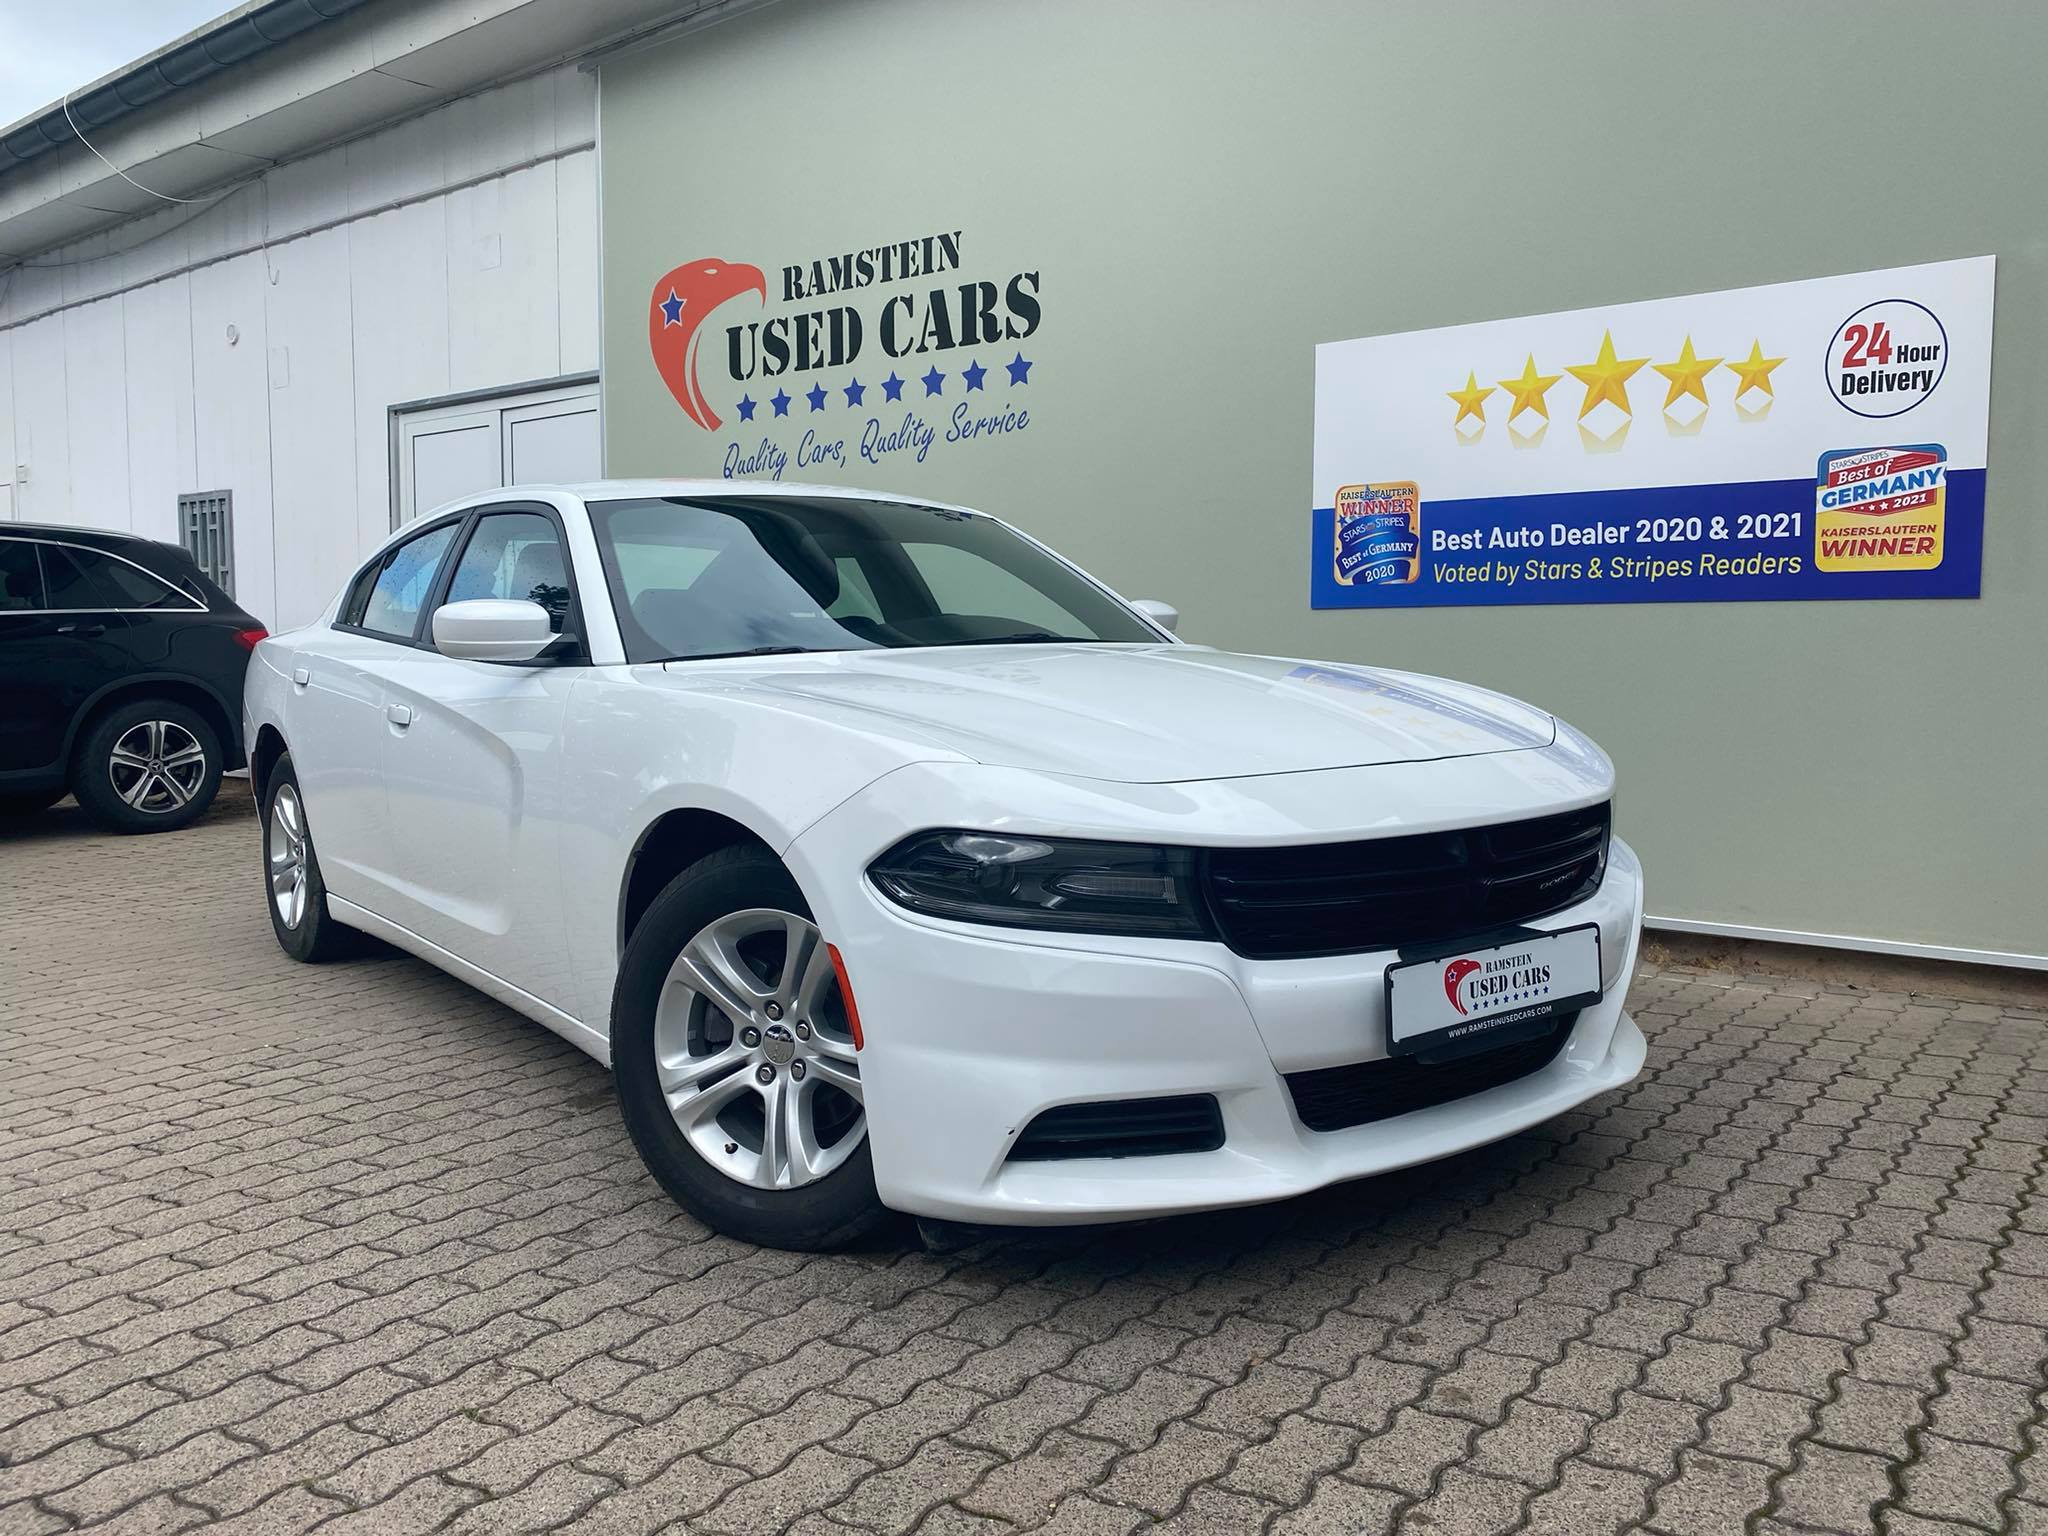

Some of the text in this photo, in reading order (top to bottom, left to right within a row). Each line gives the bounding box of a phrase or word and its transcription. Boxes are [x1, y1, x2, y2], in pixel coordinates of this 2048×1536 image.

[783, 230, 962, 302] RAMSTEIN
[726, 271, 1042, 381] USED CARS
[1842, 322, 1940, 368] 24 Hour
[1841, 369, 1934, 396] Delivery
[723, 402, 1030, 481] Quality Cars, Quality Service
[1837, 459, 1894, 485] Best of
[1340, 487, 1414, 501] KAISERSLAUTERN
[1821, 466, 1942, 508] GERMANY
[1340, 498, 1414, 517] WINNER
[1892, 493, 1927, 509] 2021
[1343, 517, 1405, 542] STARS STRIPES
[1432, 512, 1802, 551] Best Auto Dealer 2020 & 2021
[1821, 524, 1937, 538] KAISERSLAUTERN
[1368, 542, 1414, 556] GERMANY
[1822, 536, 1935, 558] WINNER
[1365, 564, 1396, 582] 2020
[1434, 552, 1802, 587] Voted by Stars & Stripes Readers
[1485, 953, 1534, 975] RAMSTEIN
[1469, 964, 1551, 1000] USED CARS
[1448, 1004, 1553, 1039] WWW.RAMSTEINUSEDCARS.COM
